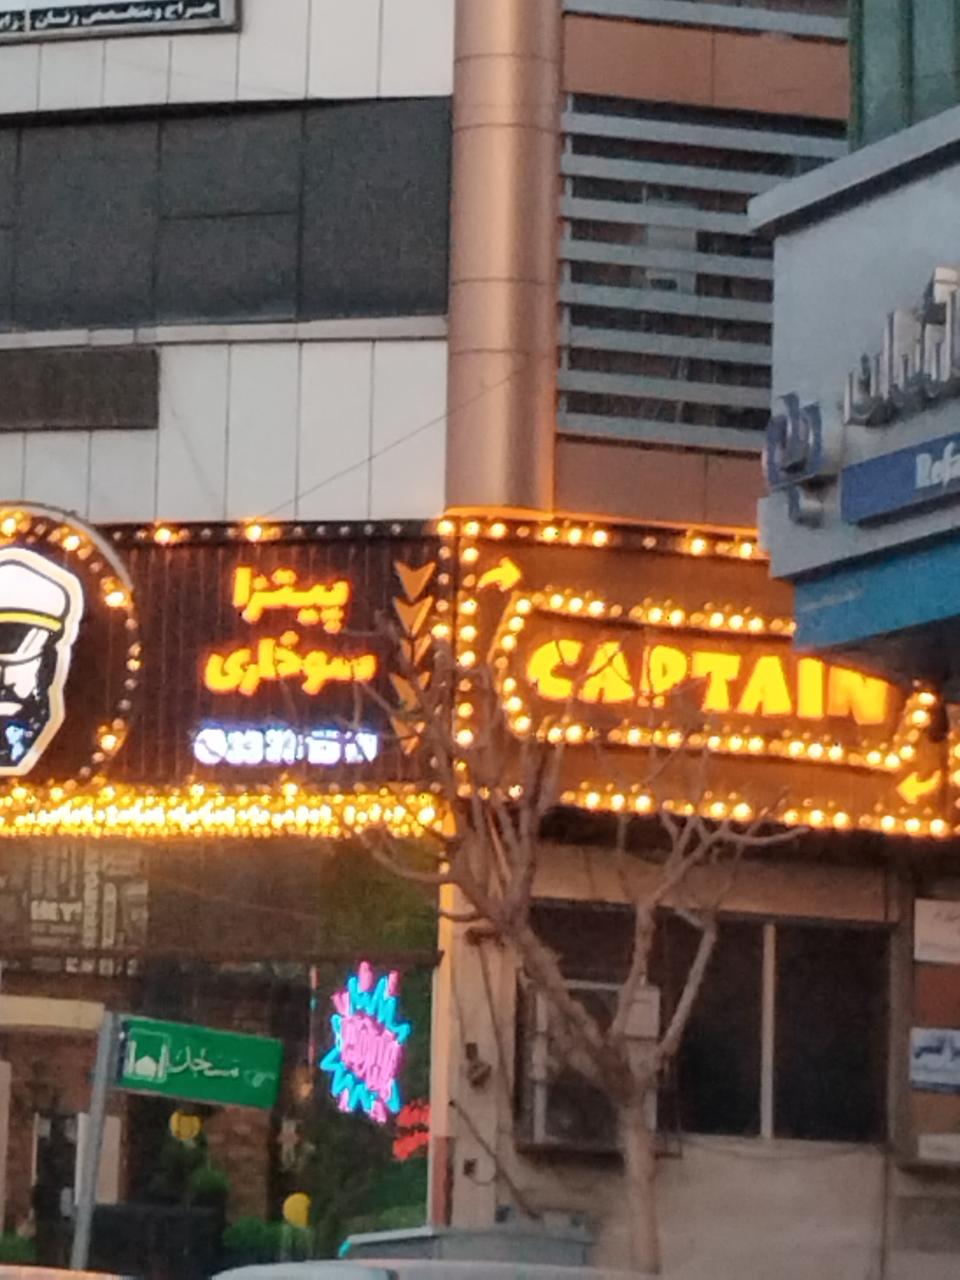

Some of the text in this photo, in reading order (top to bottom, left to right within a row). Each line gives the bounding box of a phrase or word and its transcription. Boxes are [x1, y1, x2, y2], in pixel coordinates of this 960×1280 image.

[233, 566, 349, 634] پیتزا
[205, 631, 378, 697] سوخاری
[526, 638, 892, 725] CAPTAIN
